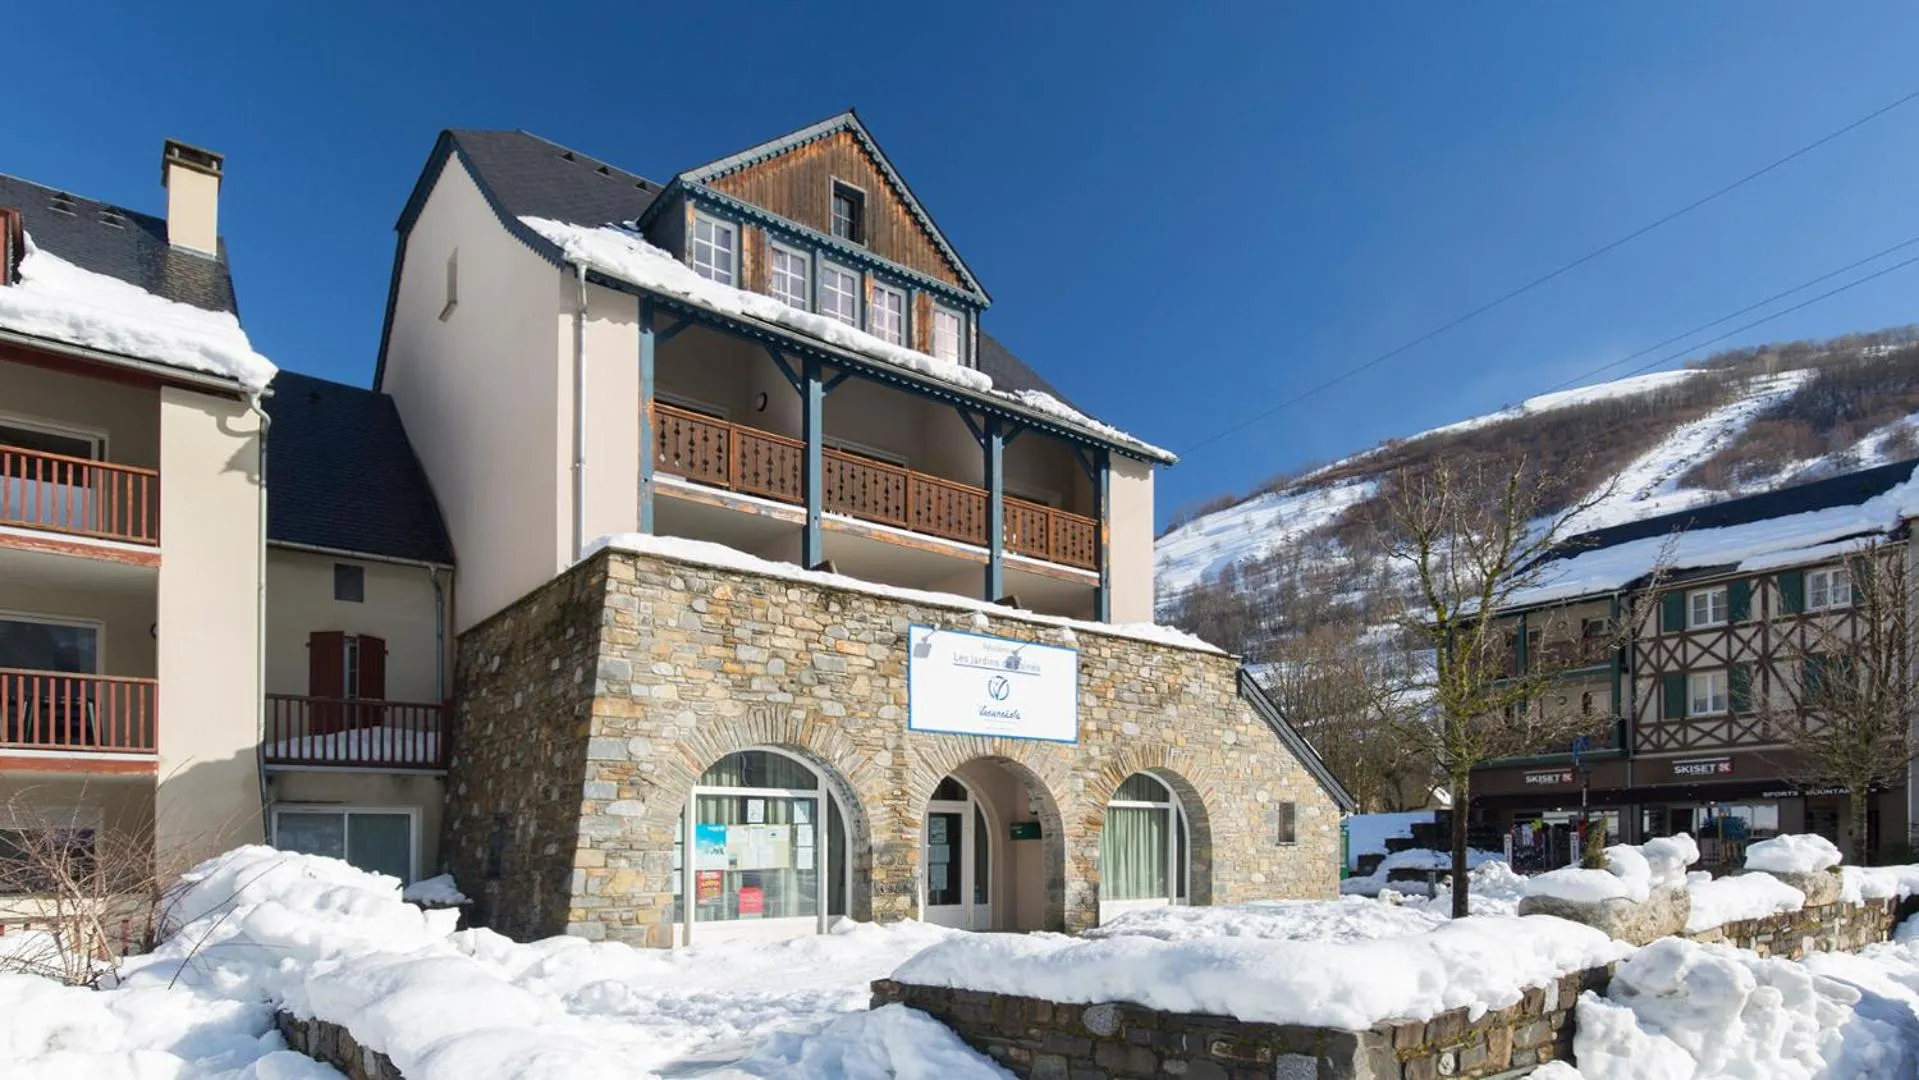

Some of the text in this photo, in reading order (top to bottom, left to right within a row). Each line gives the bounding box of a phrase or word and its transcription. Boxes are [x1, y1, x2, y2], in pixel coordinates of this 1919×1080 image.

[1673, 763, 1717, 775] SKISET
[1525, 773, 1560, 784] SKISET
[1762, 788, 1799, 798] SPORTS
